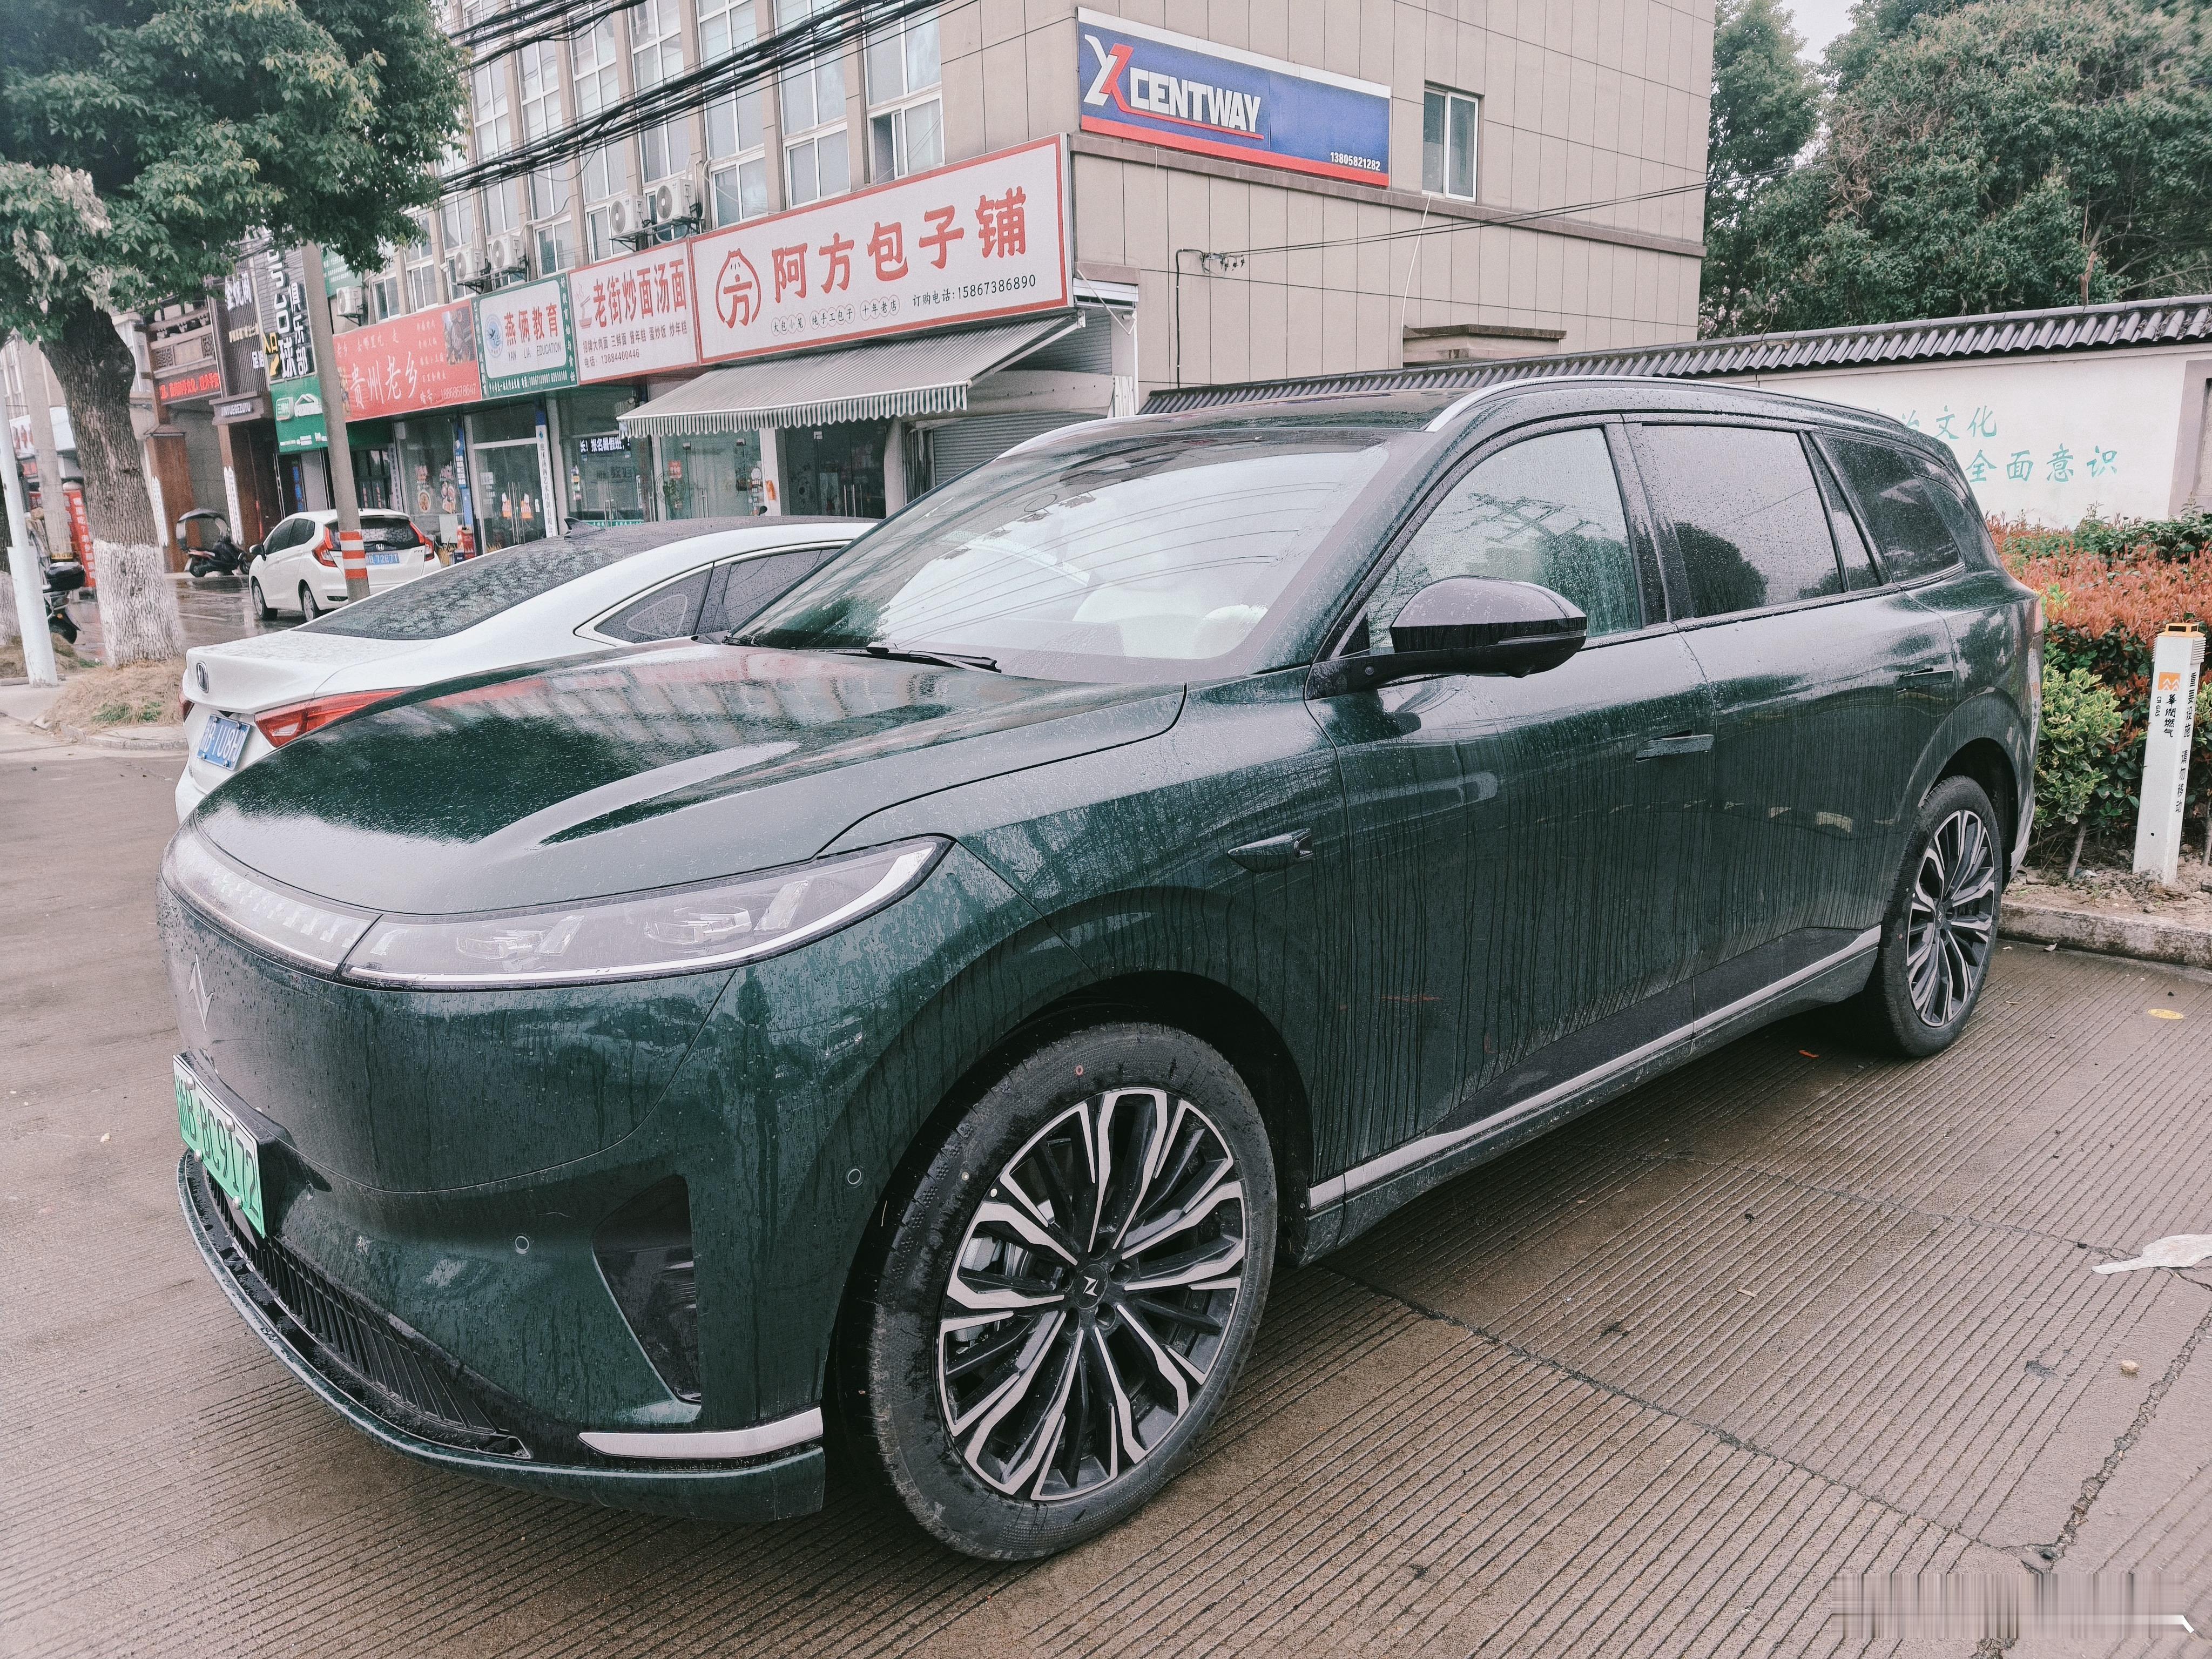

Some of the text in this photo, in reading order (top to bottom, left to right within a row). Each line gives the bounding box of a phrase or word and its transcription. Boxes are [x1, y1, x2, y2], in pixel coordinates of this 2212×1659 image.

[1330, 152, 1381, 171] 13805821282
[771, 186, 1028, 304] 阿方包子铺
[594, 258, 687, 327] 老街炒面汤面
[723, 274, 753, 328] 方
[812, 308, 853, 325] 纯手工包子
[862, 299, 896, 316] 十年老店
[263, 332, 278, 354] 入口
[288, 282, 308, 375] 俱乐部
[504, 302, 558, 347] 燕俩教育
[611, 332, 627, 347] 三鲜面
[649, 325, 666, 340] 蛋炒饭
[669, 320, 687, 338] 炒年糕
[508, 350, 517, 362] YAN
[536, 341, 561, 356] EDUCATION
[350, 351, 417, 409] 贵州老乡
[1965, 443, 2117, 483] 全面意识
